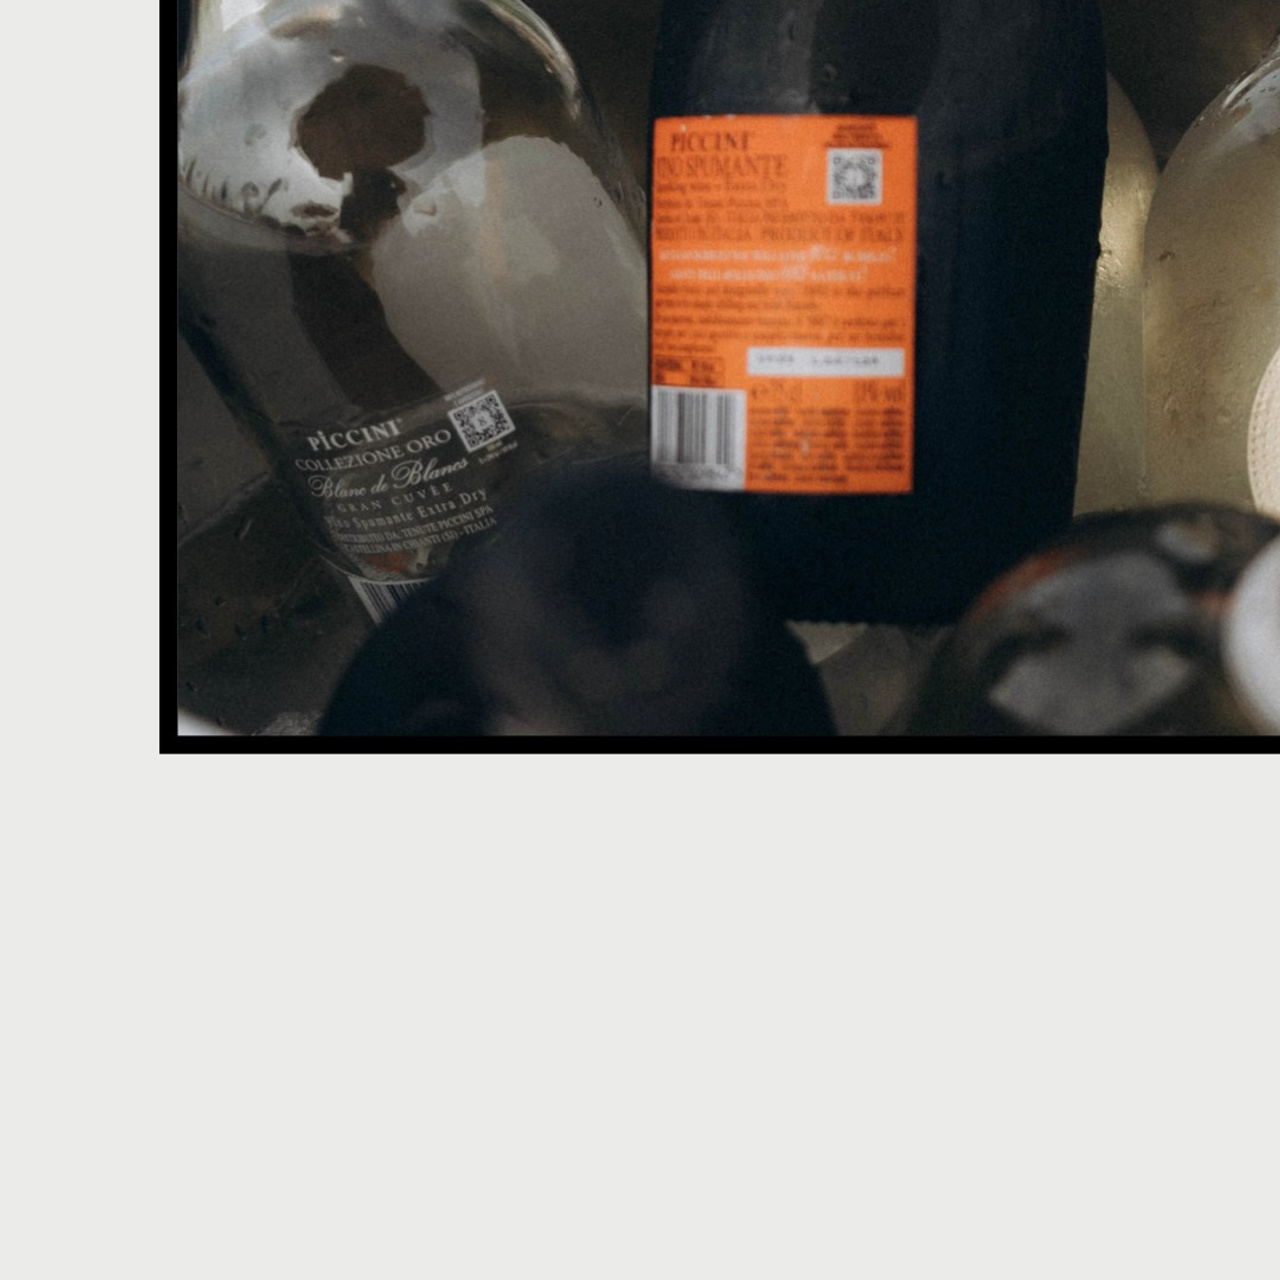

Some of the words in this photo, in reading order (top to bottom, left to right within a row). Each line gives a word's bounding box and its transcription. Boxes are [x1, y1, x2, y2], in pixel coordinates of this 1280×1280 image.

[296, 444, 405, 471] COLLEZIONE
[406, 429, 452, 454] ORO
[307, 474, 366, 498] Blanc
[370, 474, 390, 495] de
[391, 457, 469, 490] Blancs
[336, 499, 382, 514] GRAN
[417, 499, 456, 520] Extra
[460, 486, 487, 506] Dry
